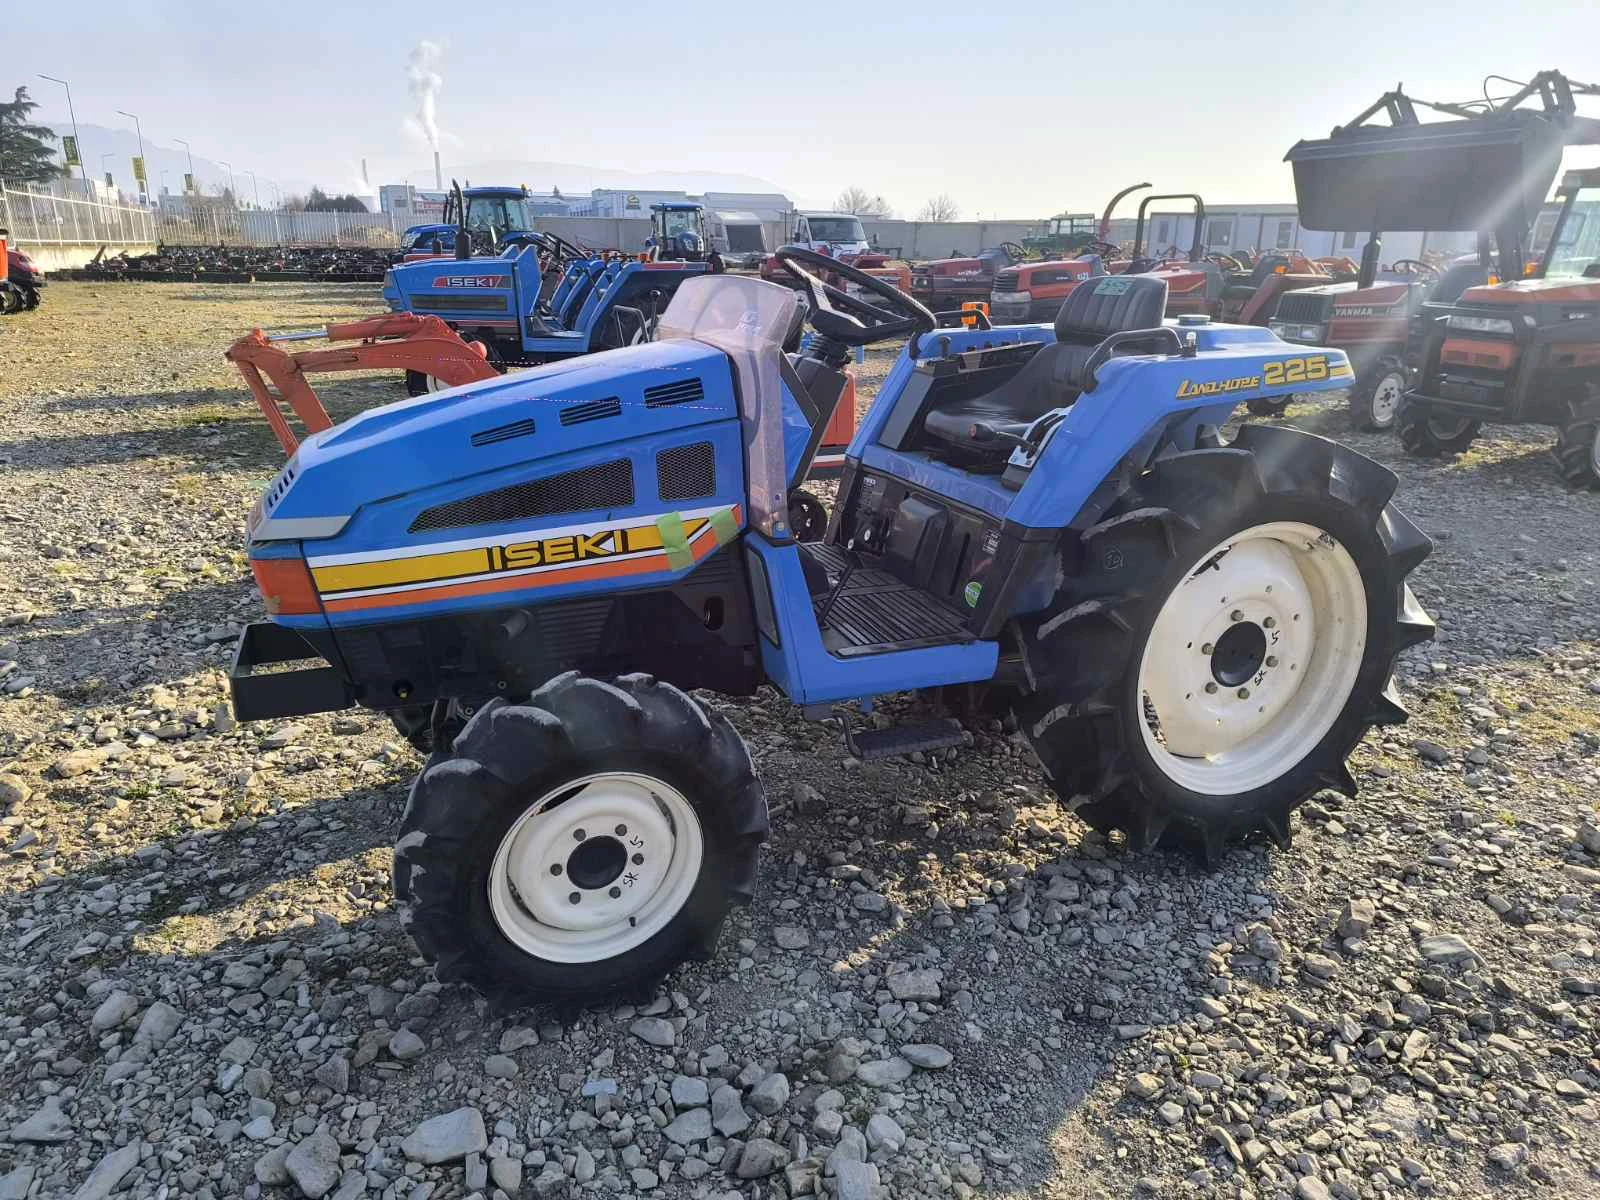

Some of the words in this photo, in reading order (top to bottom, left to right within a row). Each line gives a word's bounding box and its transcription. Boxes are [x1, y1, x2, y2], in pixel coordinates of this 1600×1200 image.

[447, 277, 494, 287] ISEKI
[1334, 307, 1373, 317] YANMAR
[1263, 354, 1329, 387] 225
[491, 528, 624, 571] ISEKI
